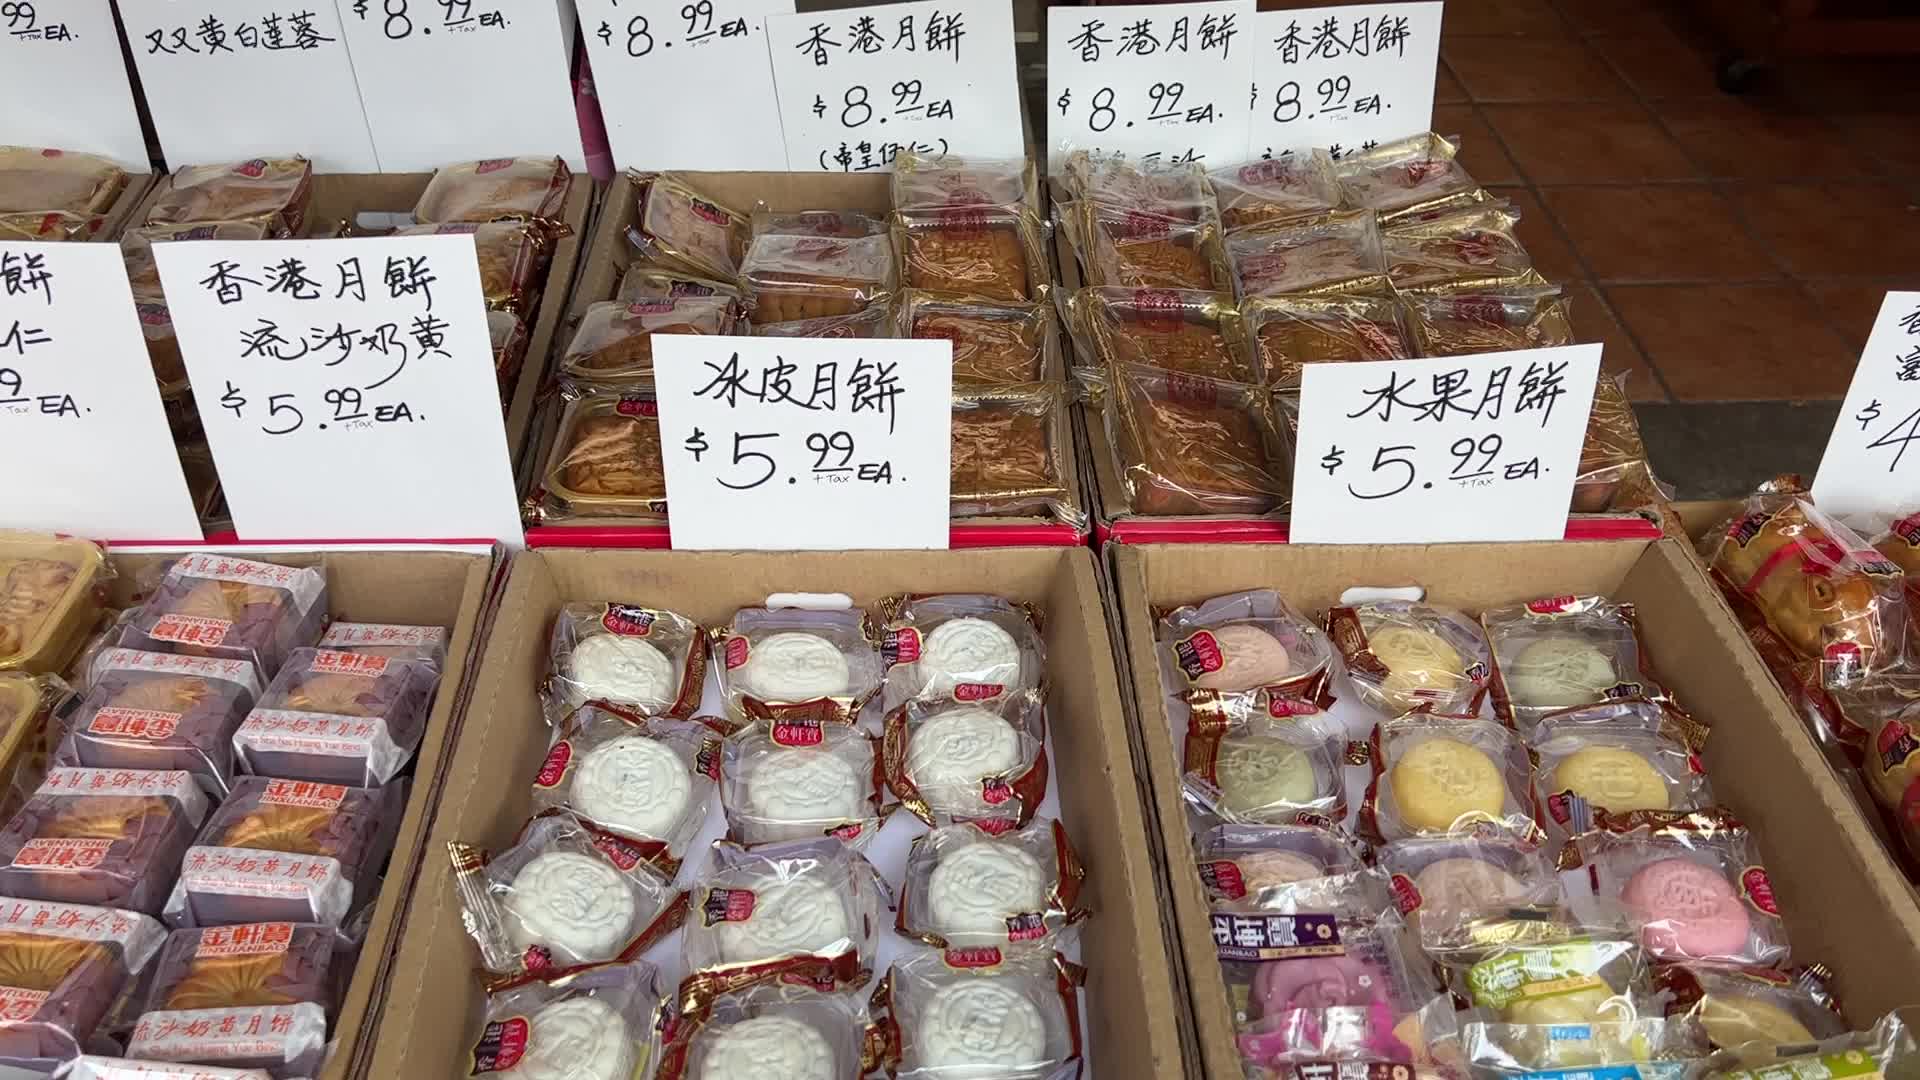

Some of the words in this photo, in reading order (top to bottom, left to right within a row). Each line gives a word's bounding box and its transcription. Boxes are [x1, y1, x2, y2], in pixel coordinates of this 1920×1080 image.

[796, 10, 966, 66] 香港月餅
[1068, 14, 1238, 63] 香港月餅
[1273, 14, 1411, 64] 香港月餅
[926, 99, 954, 120] EA
[0, 251, 53, 305] 餅
[200, 256, 437, 312] 香港月餅
[240, 315, 452, 390] 流沙奶黄
[693, 352, 905, 436] 冰皮月餅
[1346, 361, 1569, 428] 水果月餅
